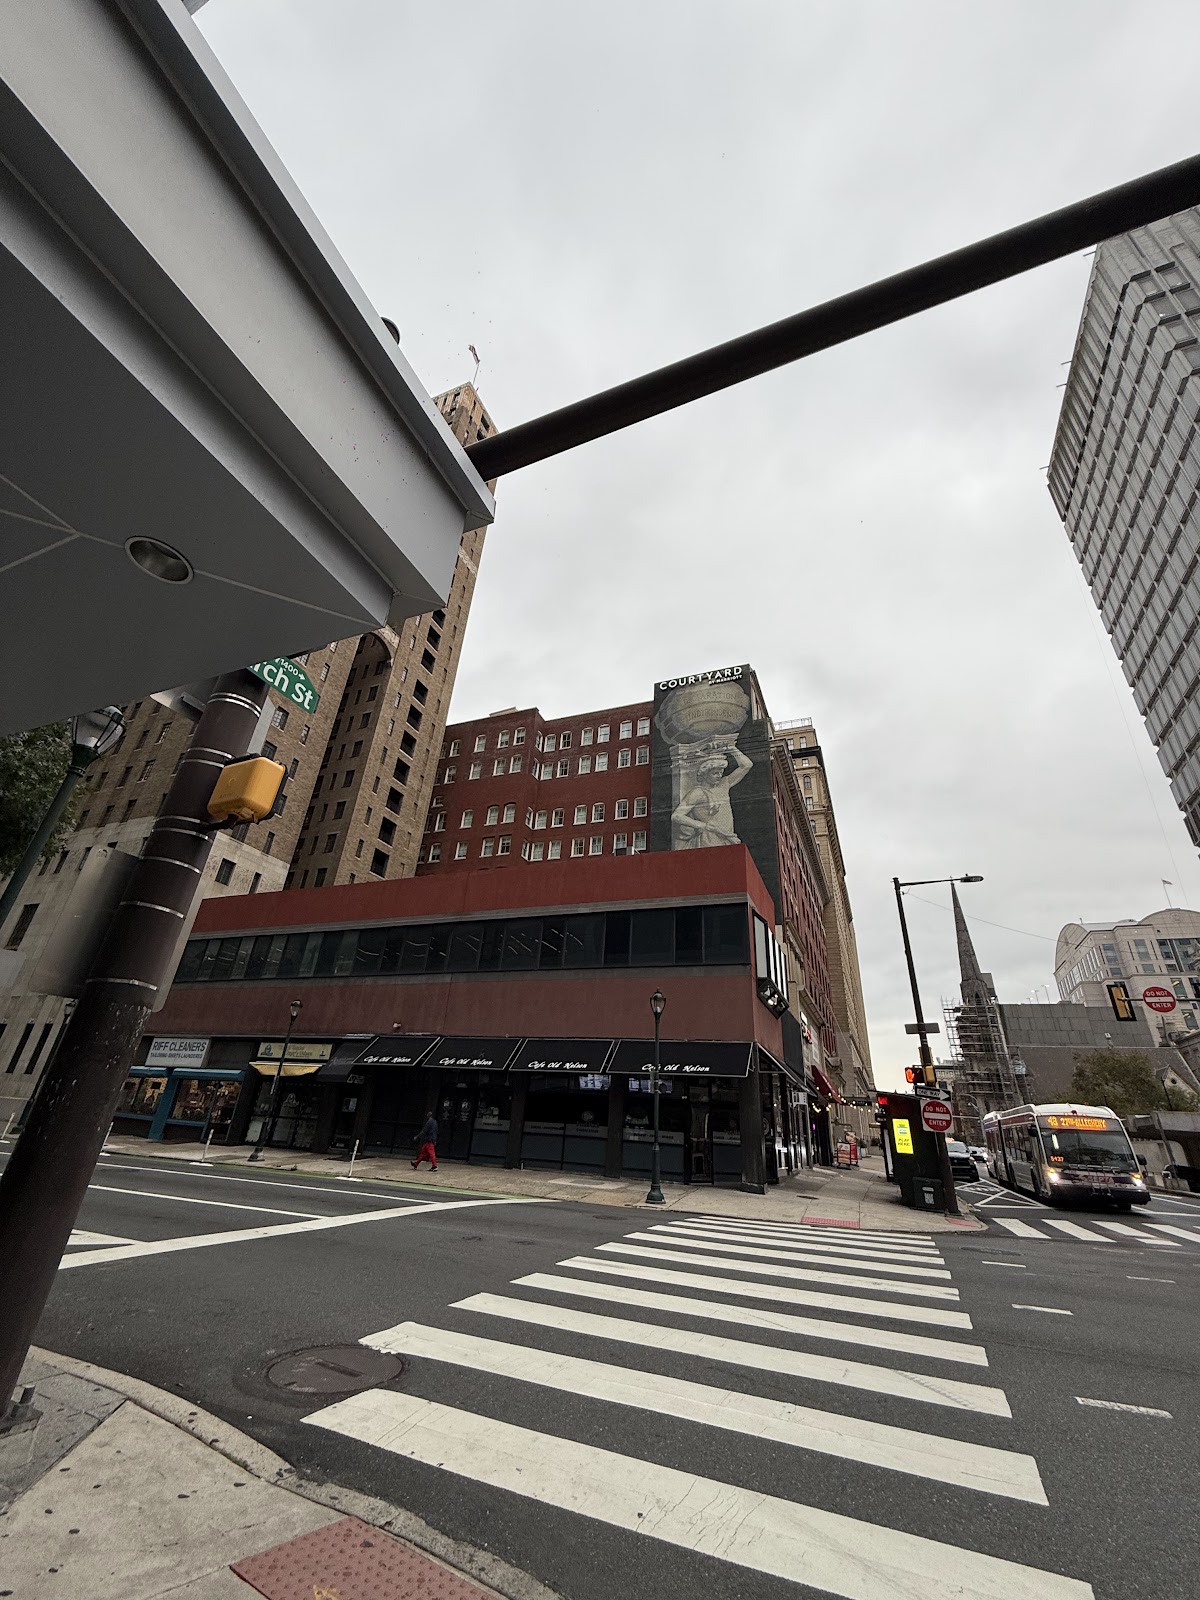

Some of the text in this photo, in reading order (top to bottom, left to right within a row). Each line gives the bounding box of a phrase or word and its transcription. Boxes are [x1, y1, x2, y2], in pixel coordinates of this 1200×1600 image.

[250, 662, 313, 709] rch St
[659, 666, 742, 690] COURTYARD
[152, 1041, 207, 1052] RIFF CLEANERS
